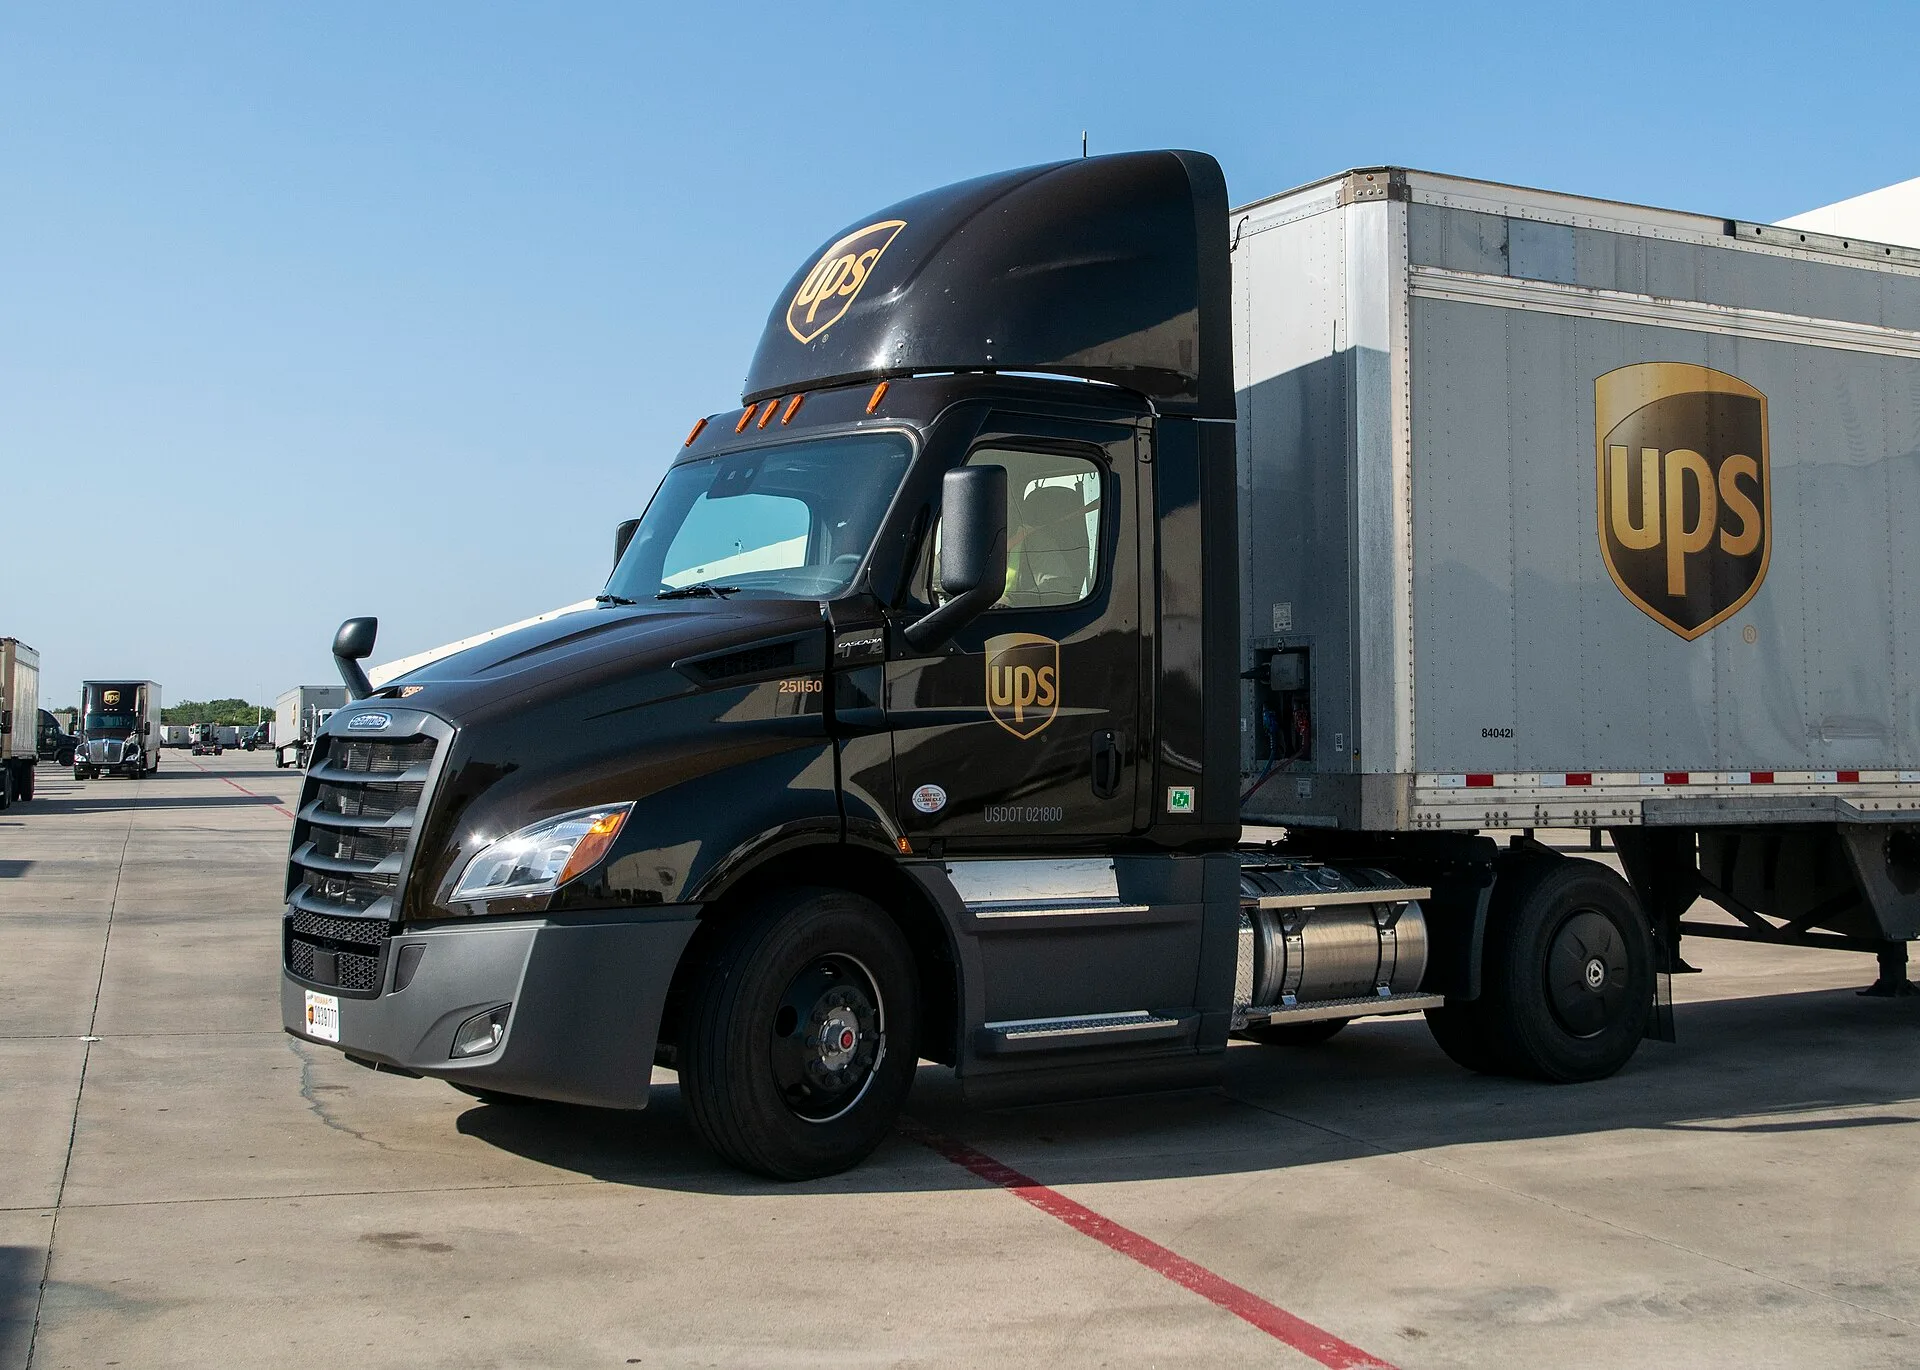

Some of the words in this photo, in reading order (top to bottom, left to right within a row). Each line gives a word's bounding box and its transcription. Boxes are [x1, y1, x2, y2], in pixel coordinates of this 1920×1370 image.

[797, 248, 880, 324] ups
[1609, 444, 1762, 597] ups
[838, 637, 882, 648] CASCADIA
[779, 680, 823, 693] 251150
[105, 694, 120, 704] ups
[991, 665, 1055, 723] ups
[1481, 728, 1513, 738] 840421
[984, 806, 1023, 822] USDOT
[1026, 806, 1063, 822] 021800
